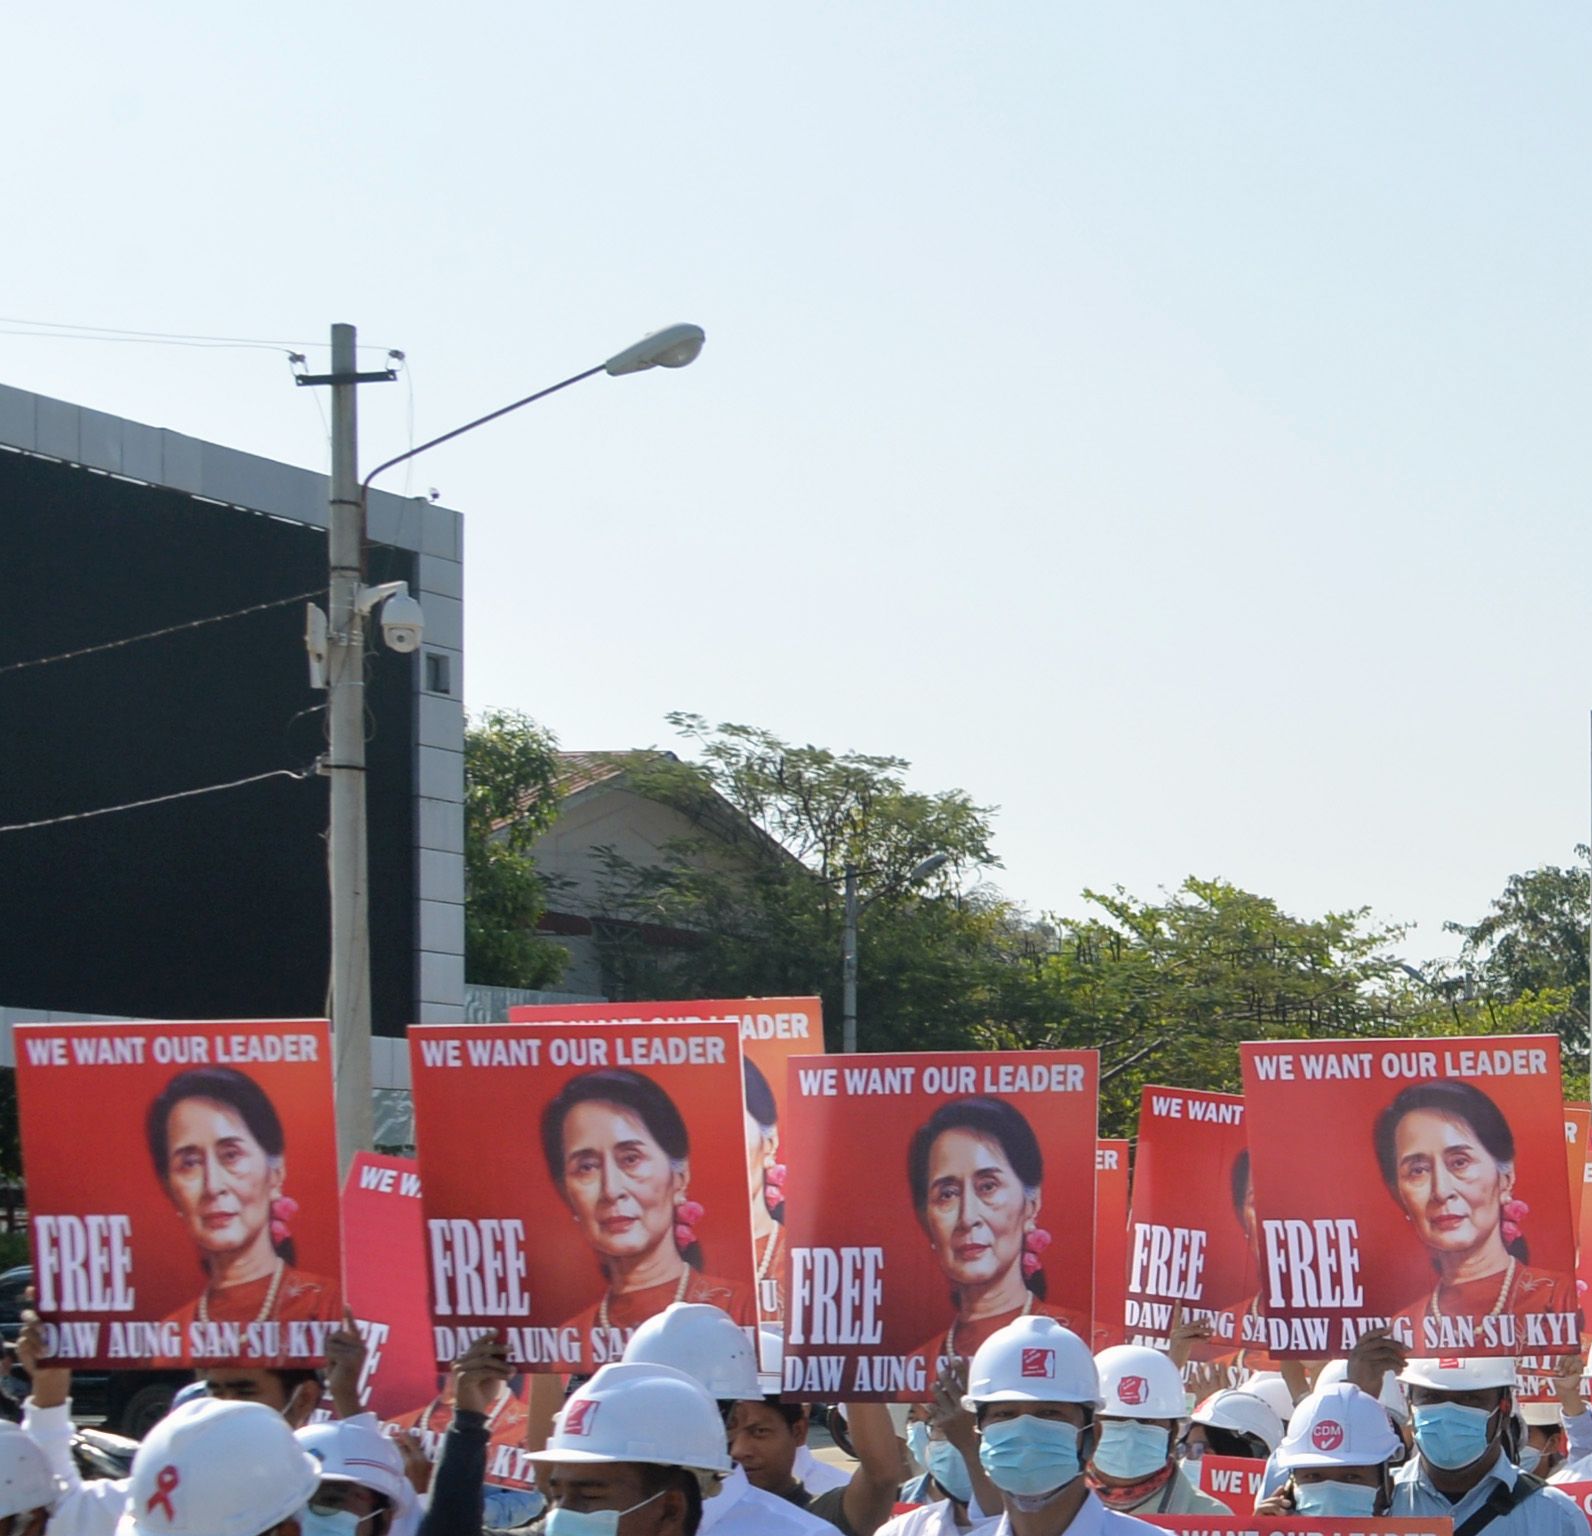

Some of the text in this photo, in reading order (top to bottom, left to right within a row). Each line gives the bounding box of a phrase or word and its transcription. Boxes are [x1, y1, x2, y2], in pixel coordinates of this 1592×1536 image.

[26, 1034, 319, 1065] WE WANT OUR LEADER
[421, 1036, 726, 1068] WE WANT OUR LEADER
[1254, 1049, 1547, 1081] WE WANT OUR LEADER
[800, 1064, 1085, 1096] WE WANT OUR LEADER
[1152, 1095, 1244, 1125] WE WANT
[360, 1166, 393, 1191] WE
[34, 1215, 135, 1312] FREE
[428, 1219, 530, 1316] FREE
[1129, 1223, 1206, 1300] FREE
[1262, 1219, 1364, 1308] FREE
[790, 1247, 884, 1345] FREE
[1125, 1300, 1172, 1330] DAW
[1269, 1317, 1329, 1350] DAW
[1525, 1312, 1579, 1346] KYI
[41, 1322, 100, 1358] DAW
[108, 1322, 182, 1358] AUNG
[507, 1327, 581, 1362] AUNG
[784, 1355, 925, 1392] DAW AUNG
[1313, 1426, 1341, 1438] CDM
[1211, 1469, 1243, 1494] WE
